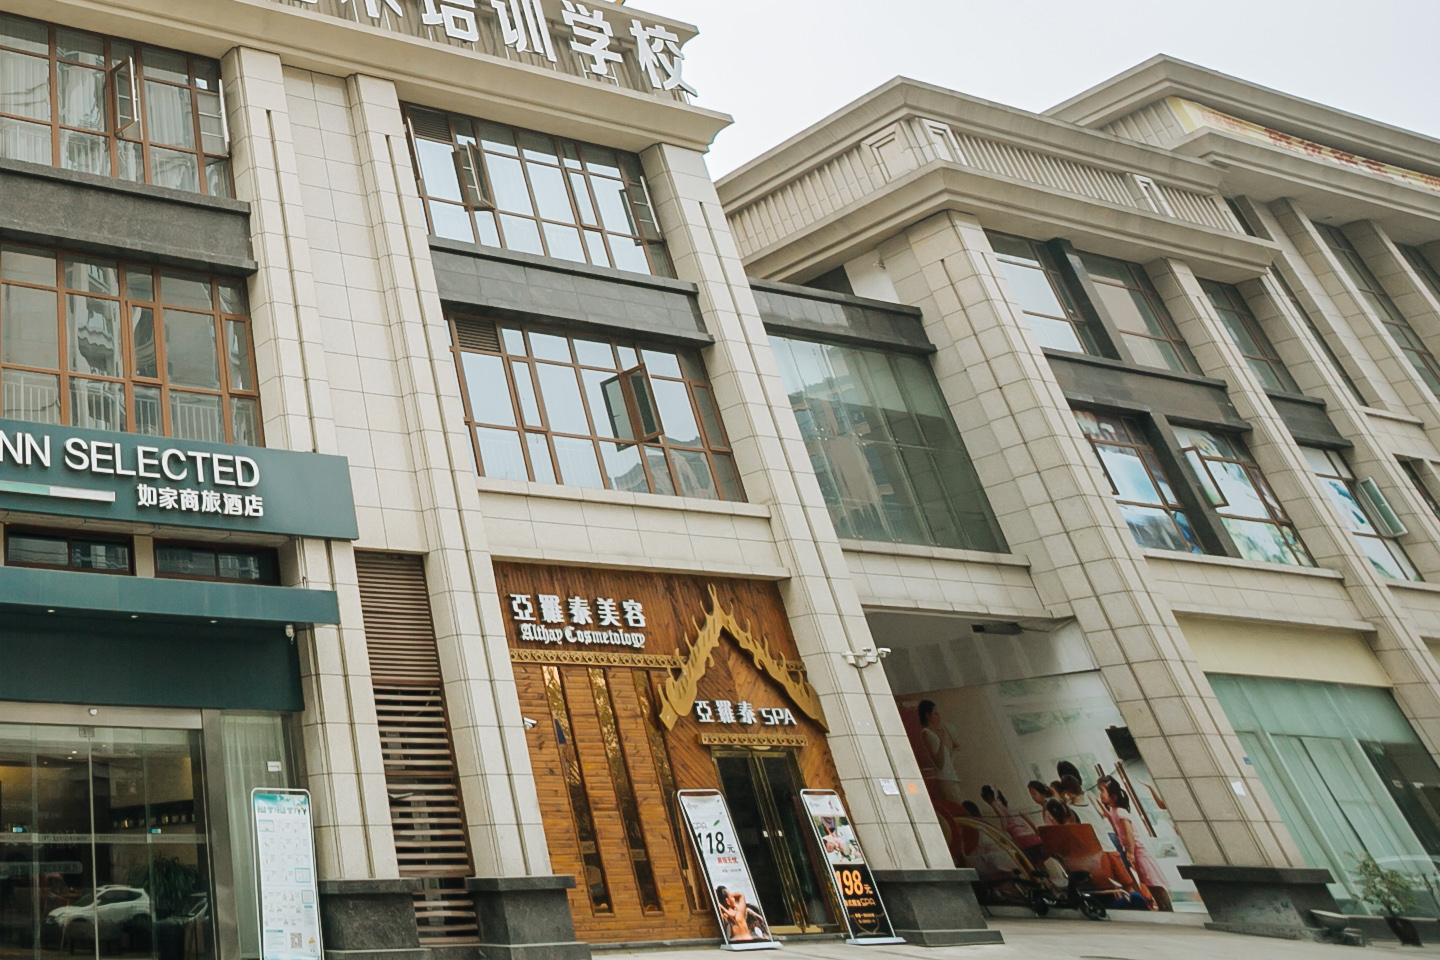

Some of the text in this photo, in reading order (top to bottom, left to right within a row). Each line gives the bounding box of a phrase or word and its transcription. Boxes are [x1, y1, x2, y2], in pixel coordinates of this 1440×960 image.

[64, 437, 261, 488] SELECTED
[137, 483, 265, 518] 如家商旅酒店
[563, 625, 646, 649] Cosmetology
[758, 707, 798, 725] SPA
